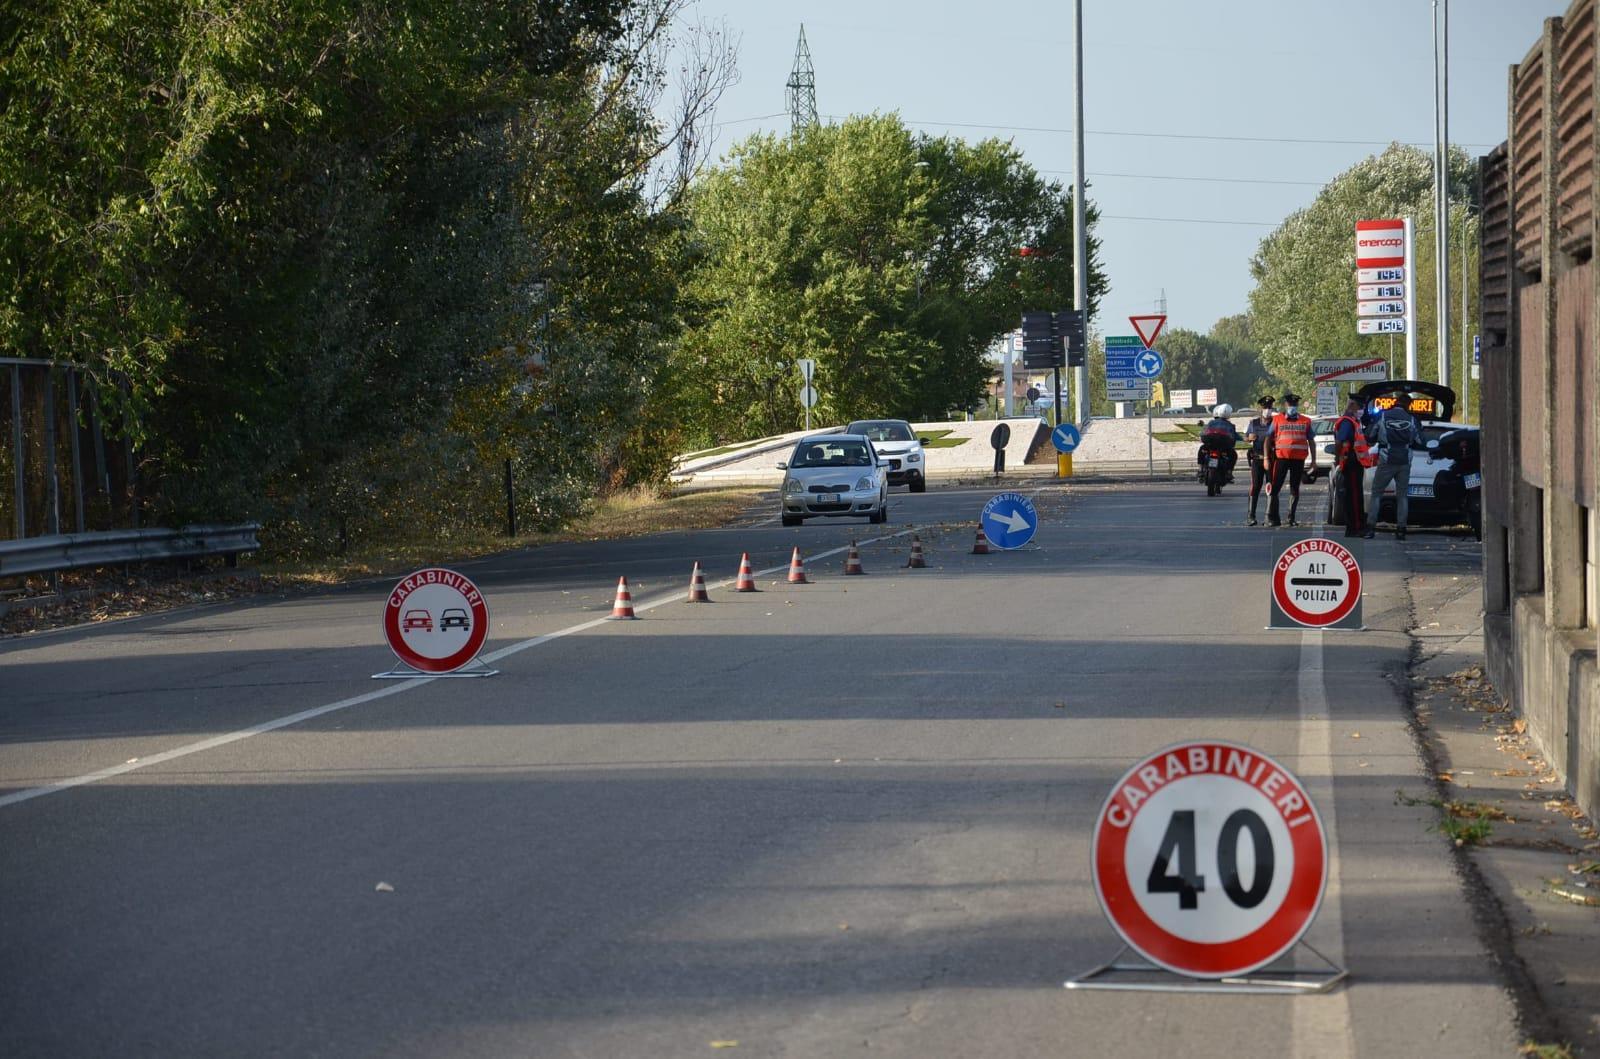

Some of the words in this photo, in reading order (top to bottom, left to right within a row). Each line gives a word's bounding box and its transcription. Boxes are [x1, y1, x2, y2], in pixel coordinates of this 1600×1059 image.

[1358, 239, 1403, 248] enercoop
[1278, 541, 1357, 572] CARABINIERI
[1308, 563, 1327, 575] ALT
[390, 571, 483, 608] CARABINIERI
[1295, 589, 1338, 602] POLIZIA
[1106, 747, 1312, 829] CARABINIERI
[1146, 808, 1275, 911] 40
